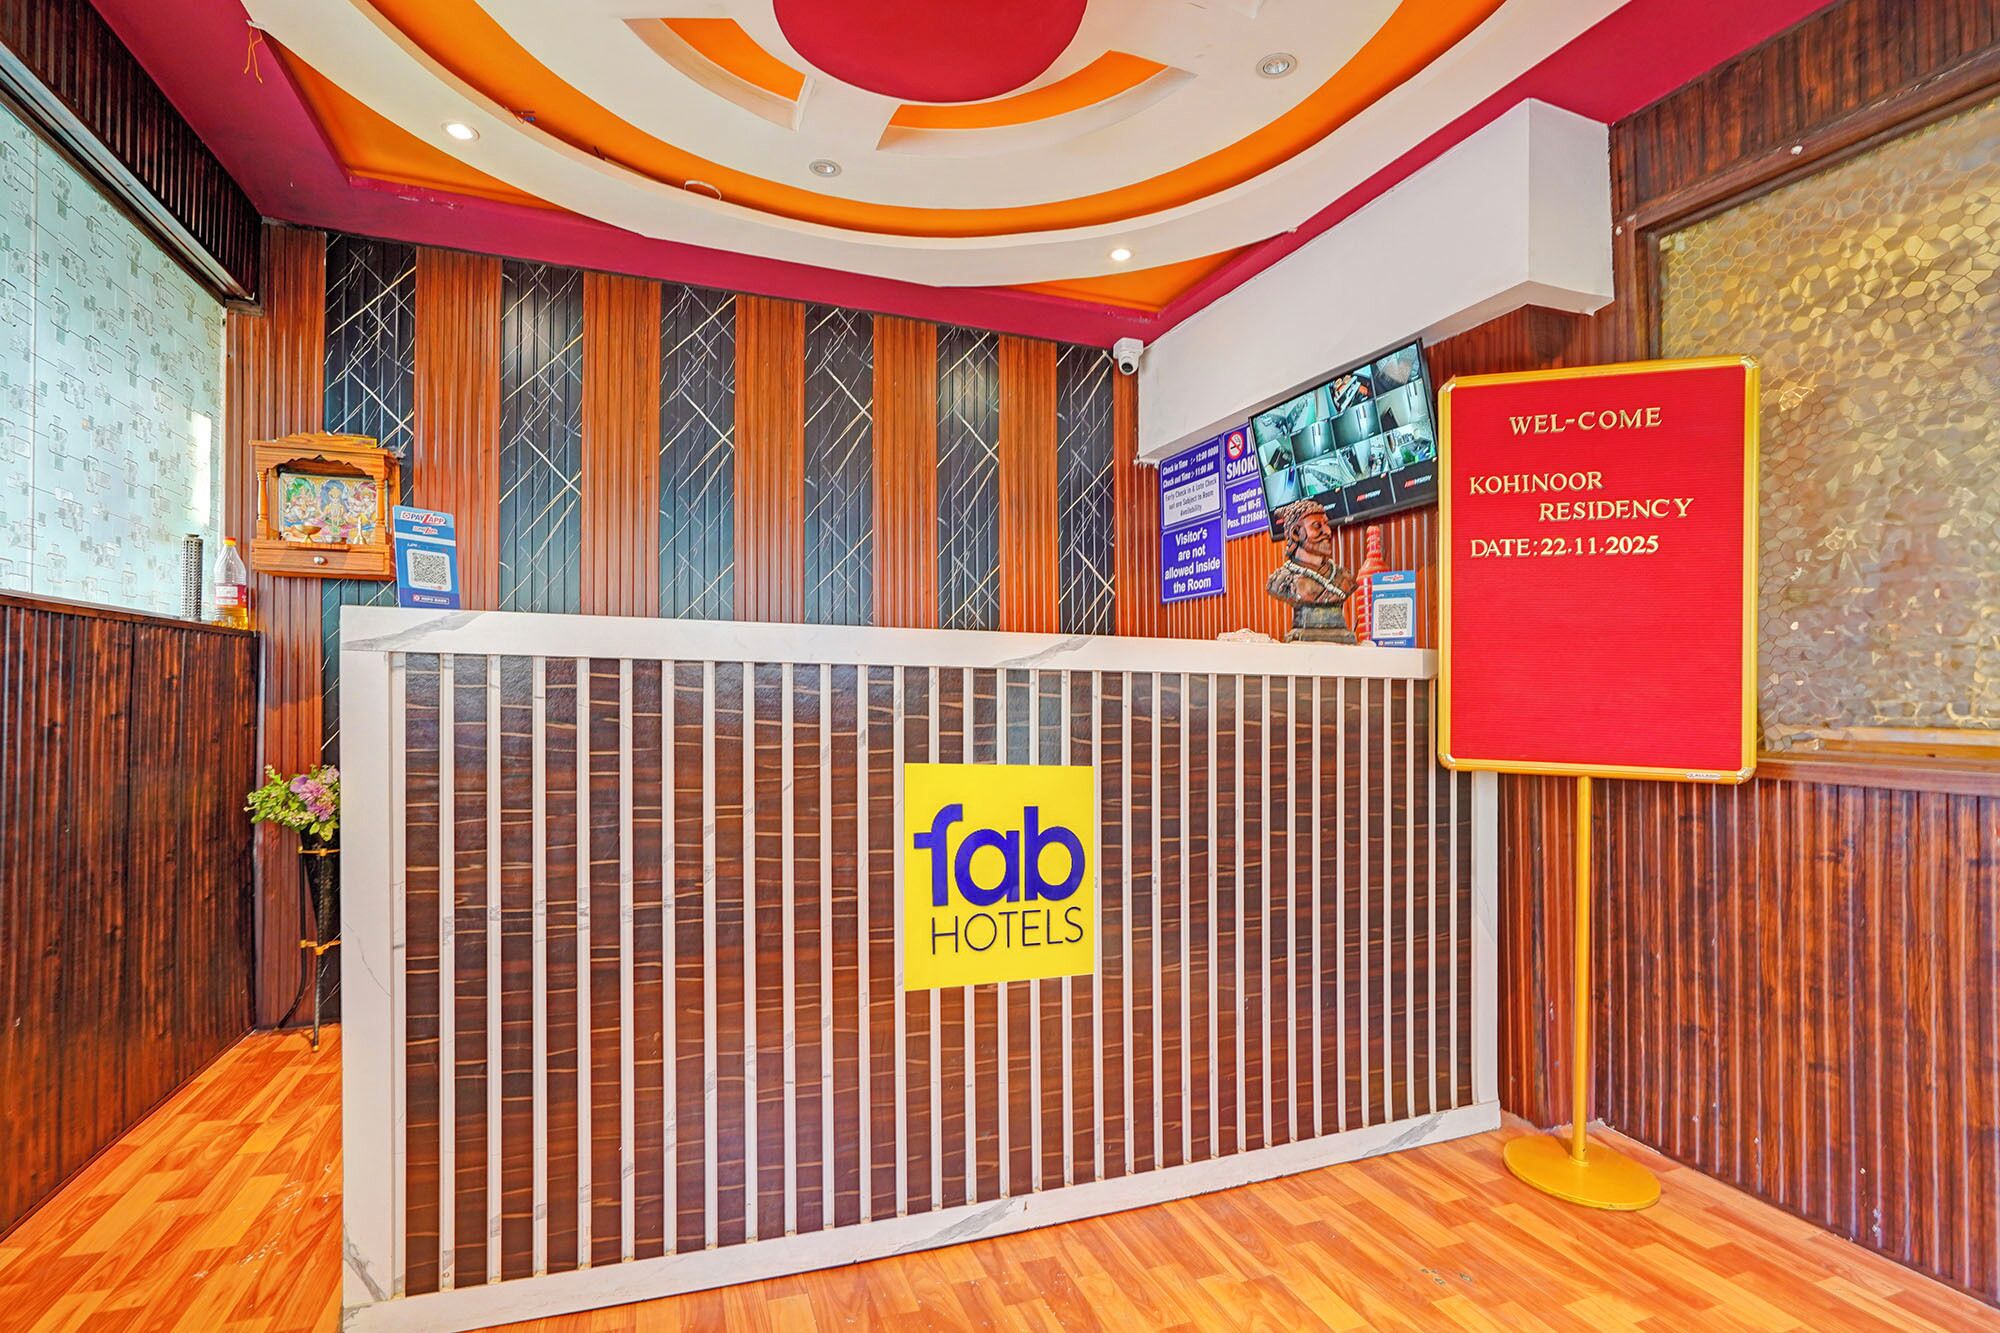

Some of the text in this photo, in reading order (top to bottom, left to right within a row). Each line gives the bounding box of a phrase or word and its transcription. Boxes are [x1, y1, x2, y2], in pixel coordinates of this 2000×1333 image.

[1509, 407, 1662, 435] WEL-COME
[1163, 465, 1174, 476] Check
[1163, 478, 1174, 488] Check
[1469, 472, 1604, 495] KOHINOOR
[1538, 498, 1694, 522] RESIDENCY
[1176, 527, 1208, 546] Visitor's
[1178, 544, 1206, 562] are not
[1165, 562, 1194, 580] allowed
[1174, 578, 1211, 594] the Room
[913, 803, 1086, 907] fab
[931, 906, 1084, 955] HOTELS
